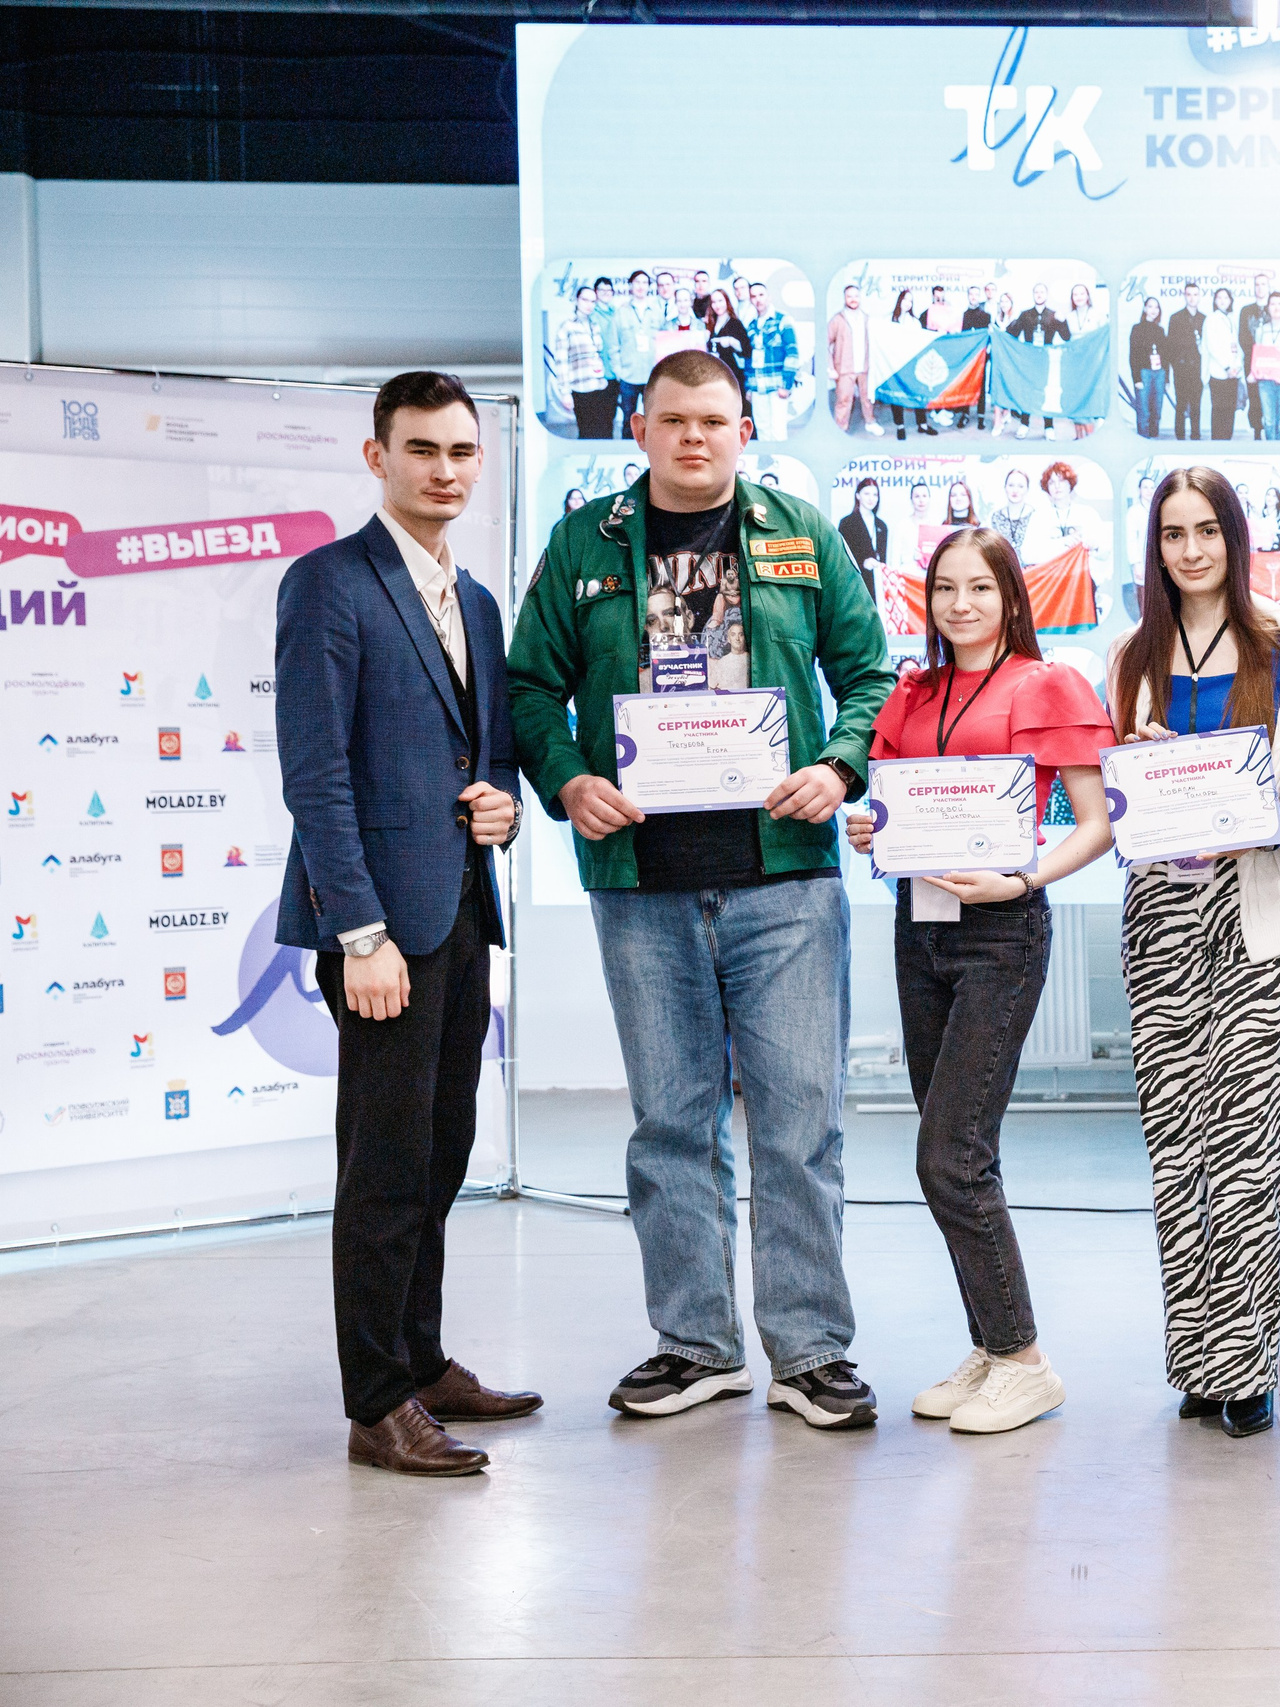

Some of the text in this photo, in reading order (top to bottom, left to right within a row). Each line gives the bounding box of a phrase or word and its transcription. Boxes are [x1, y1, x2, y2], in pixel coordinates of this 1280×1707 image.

[0, 516, 69, 547] ИОН
[116, 522, 281, 565] #ВЫЕЗД
[657, 718, 748, 731] СЕРТИФИКАТ
[66, 734, 119, 746] алабуга
[1144, 759, 1233, 781] СЕРТИФИКАТ
[1171, 775, 1206, 784] УЧАСТНИКА
[908, 784, 996, 797] СЕРТИФИКАТ
[146, 794, 227, 809] MOLADZ.BY
[69, 852, 122, 865] алабуга
[149, 911, 230, 928] MOLADZ.BY
[73, 978, 125, 991] алабуга
[252, 1081, 299, 1093] алабуга
